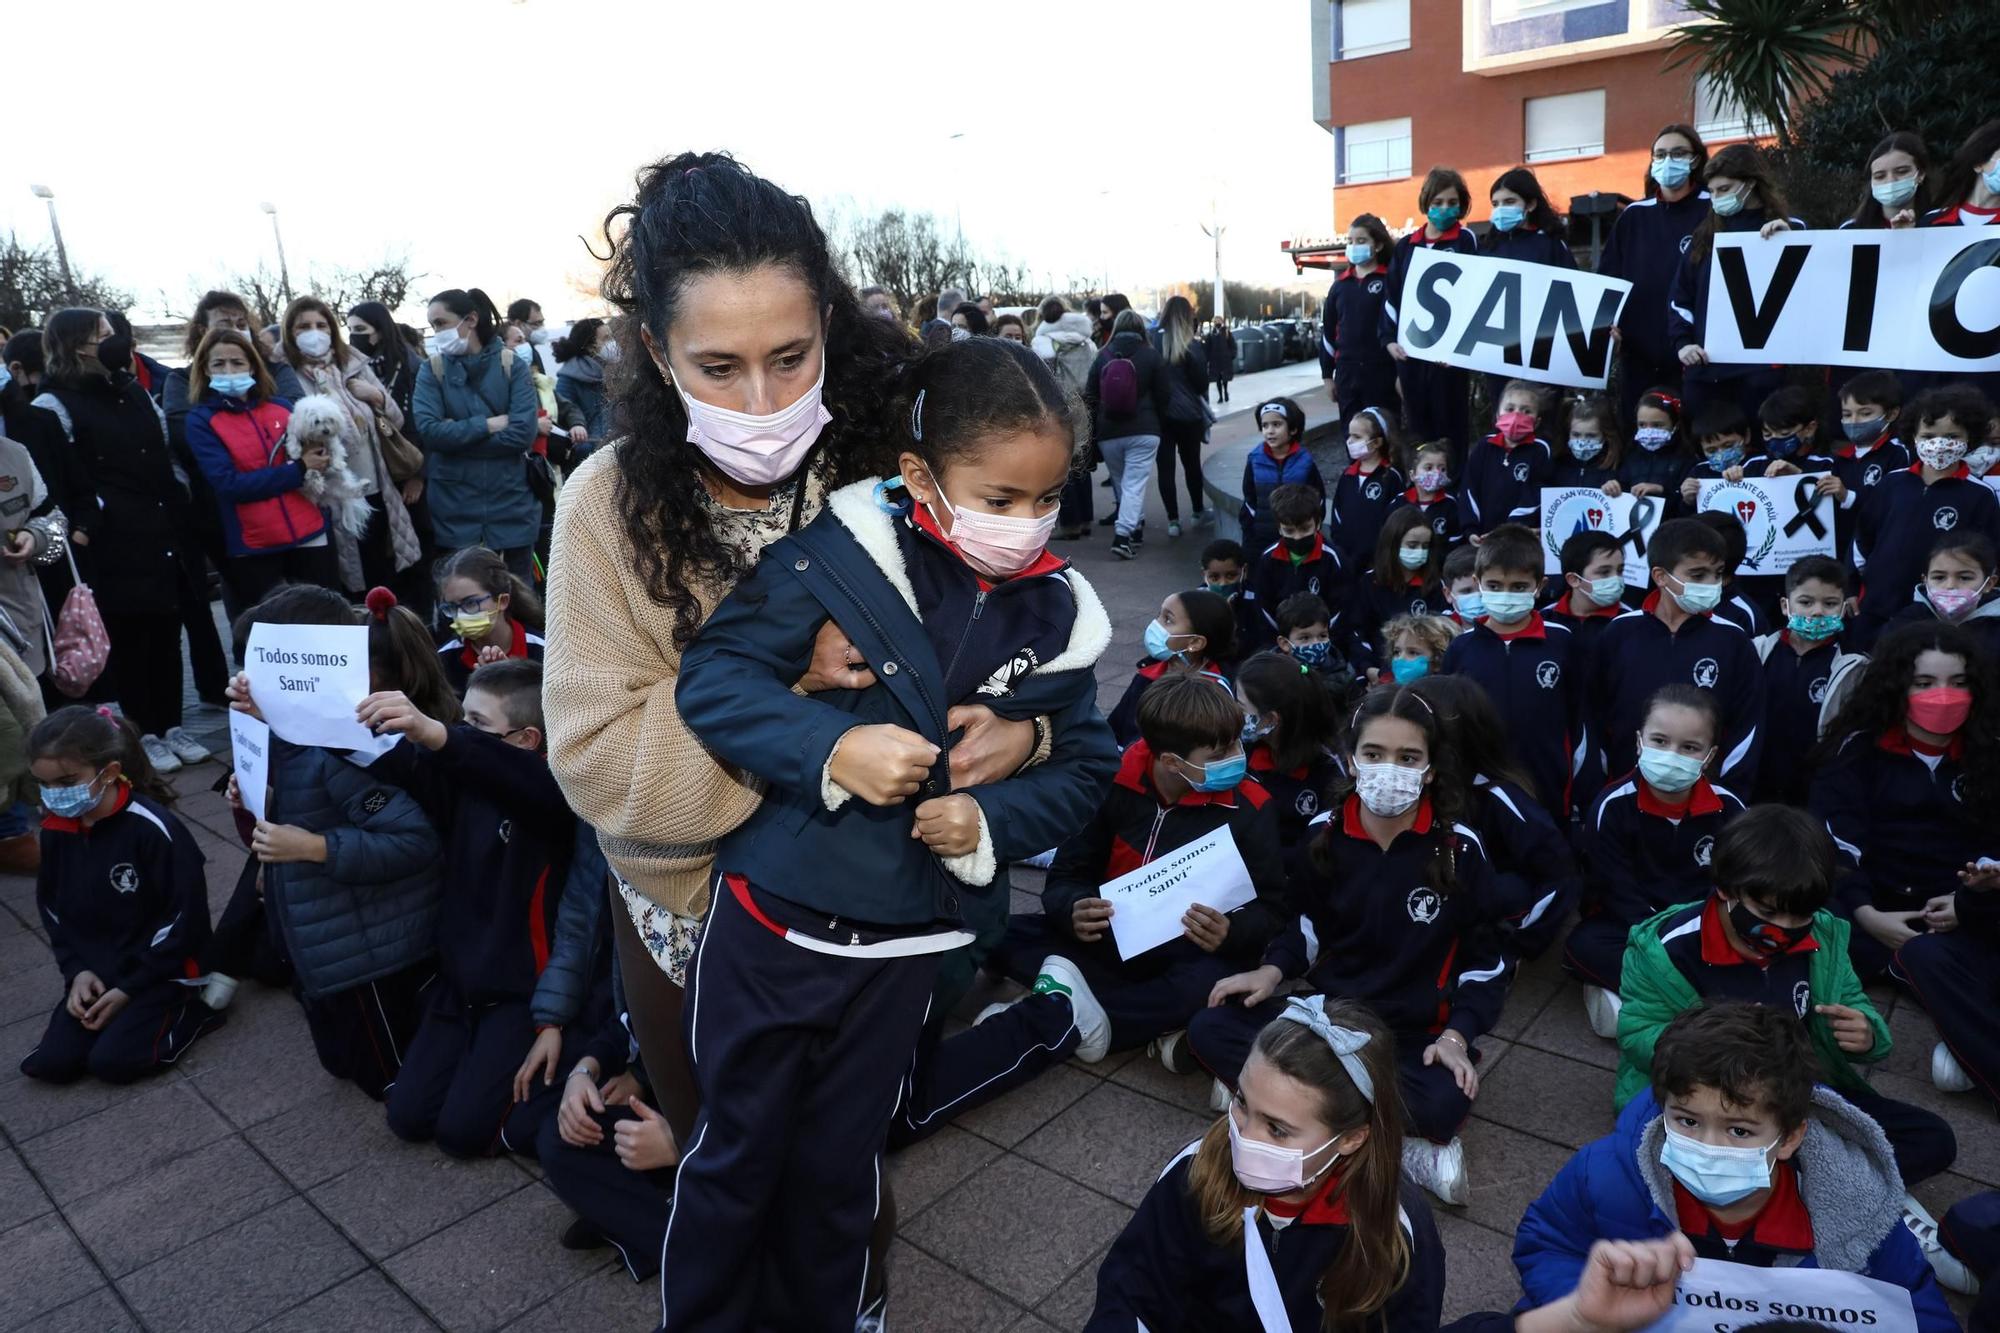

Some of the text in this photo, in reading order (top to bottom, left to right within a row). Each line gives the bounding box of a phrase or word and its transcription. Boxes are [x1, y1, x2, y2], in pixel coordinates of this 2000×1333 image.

[1405, 261, 1625, 379] SAN
[1560, 489, 1576, 502] SAN
[254, 646, 348, 667] "Todos somos
[279, 675, 320, 693] Sanvi"
[1118, 841, 1216, 894] "Todos somos
[1148, 865, 1192, 898] Sanvi"
[1768, 1301, 1877, 1325] somos
